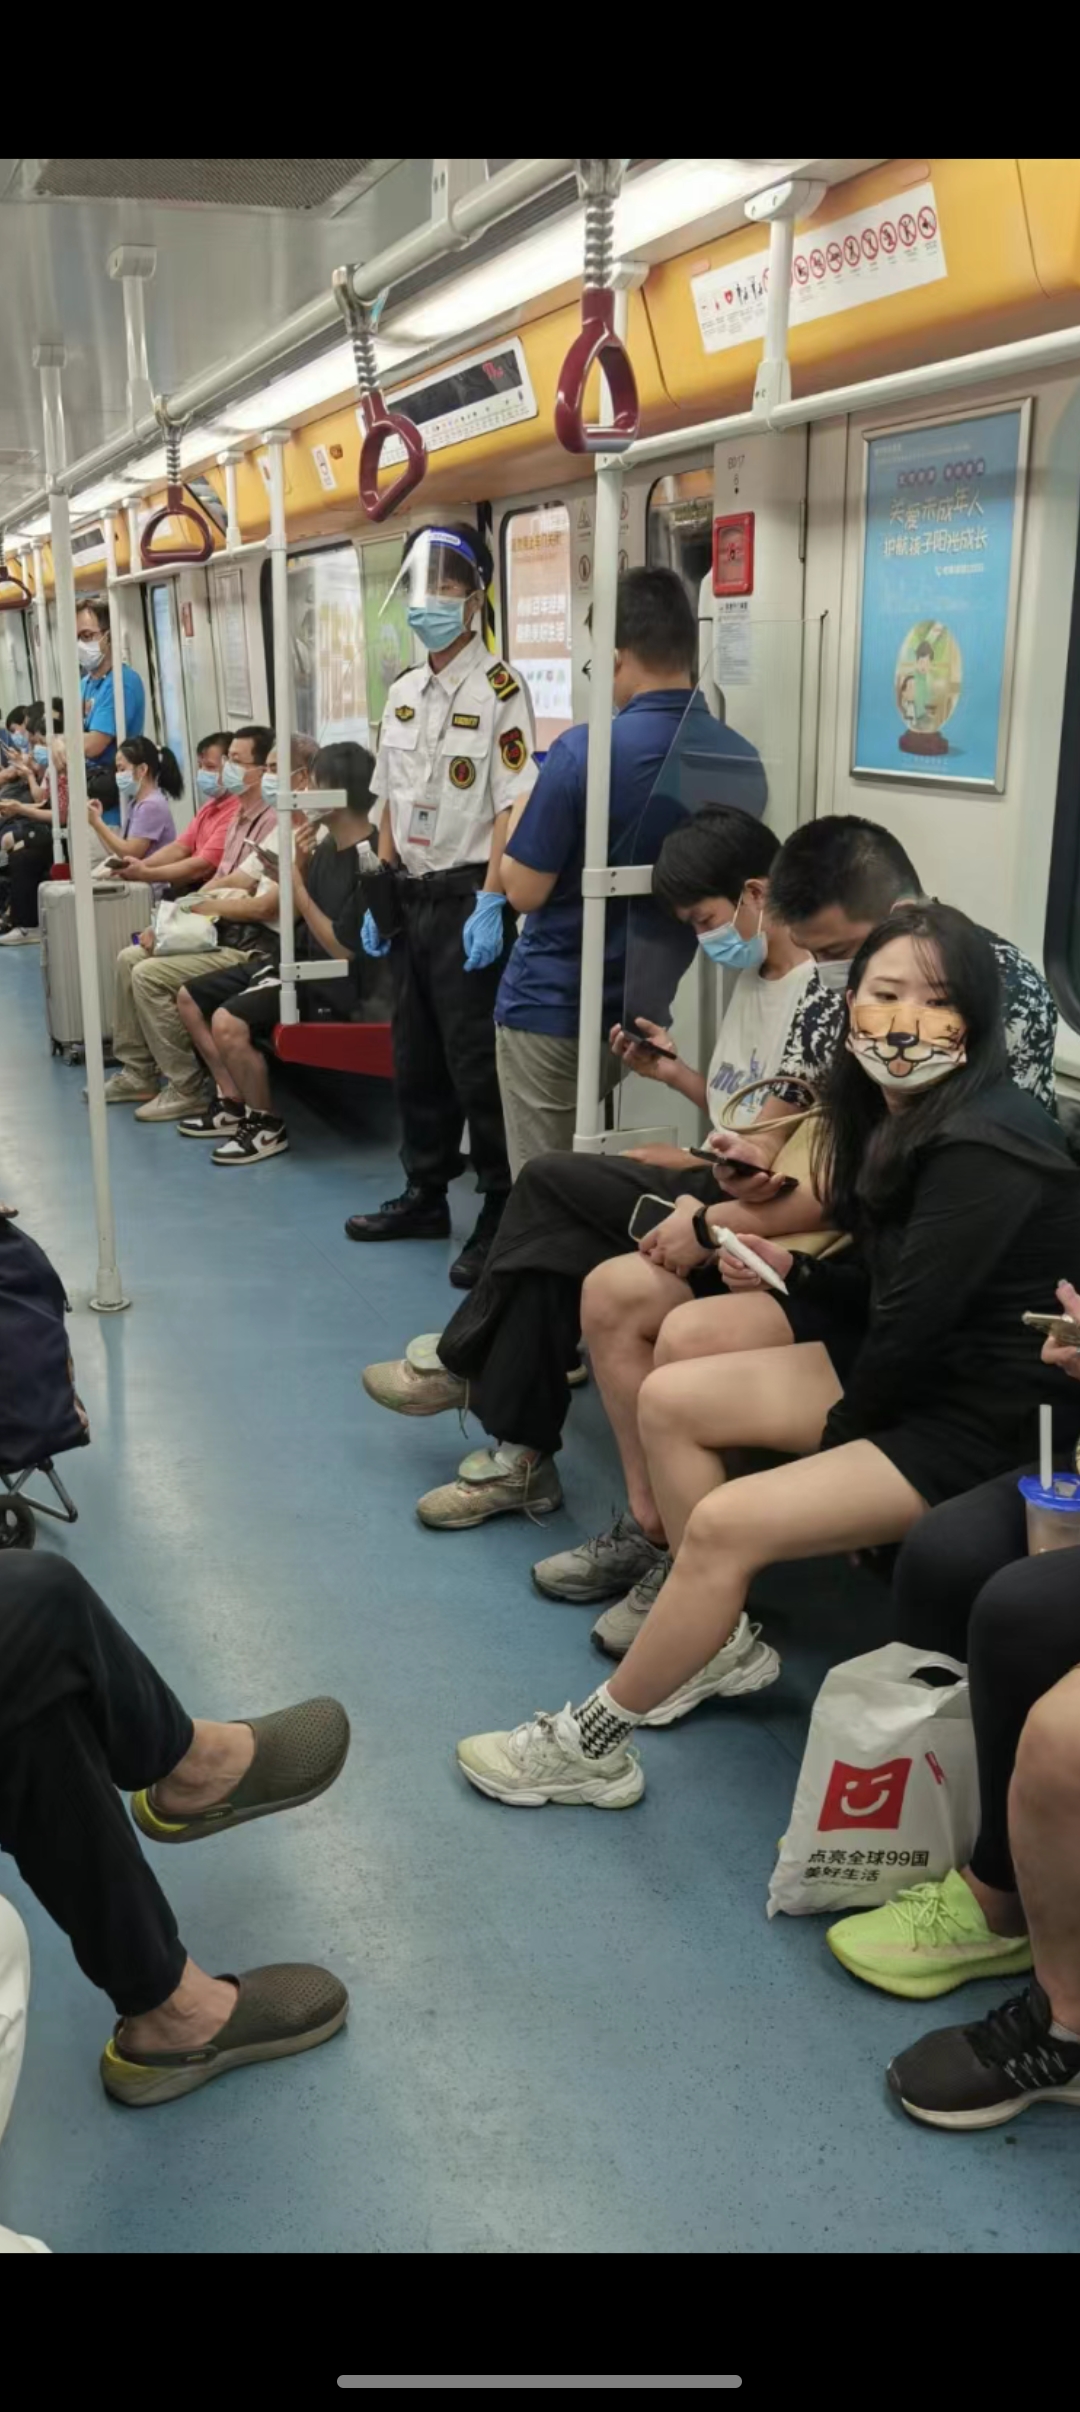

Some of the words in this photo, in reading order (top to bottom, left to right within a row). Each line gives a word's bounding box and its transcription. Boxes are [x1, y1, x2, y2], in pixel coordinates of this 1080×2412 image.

[808, 1849, 930, 1868] 点亮全球99国
[803, 1866, 881, 1882] 美好生活
